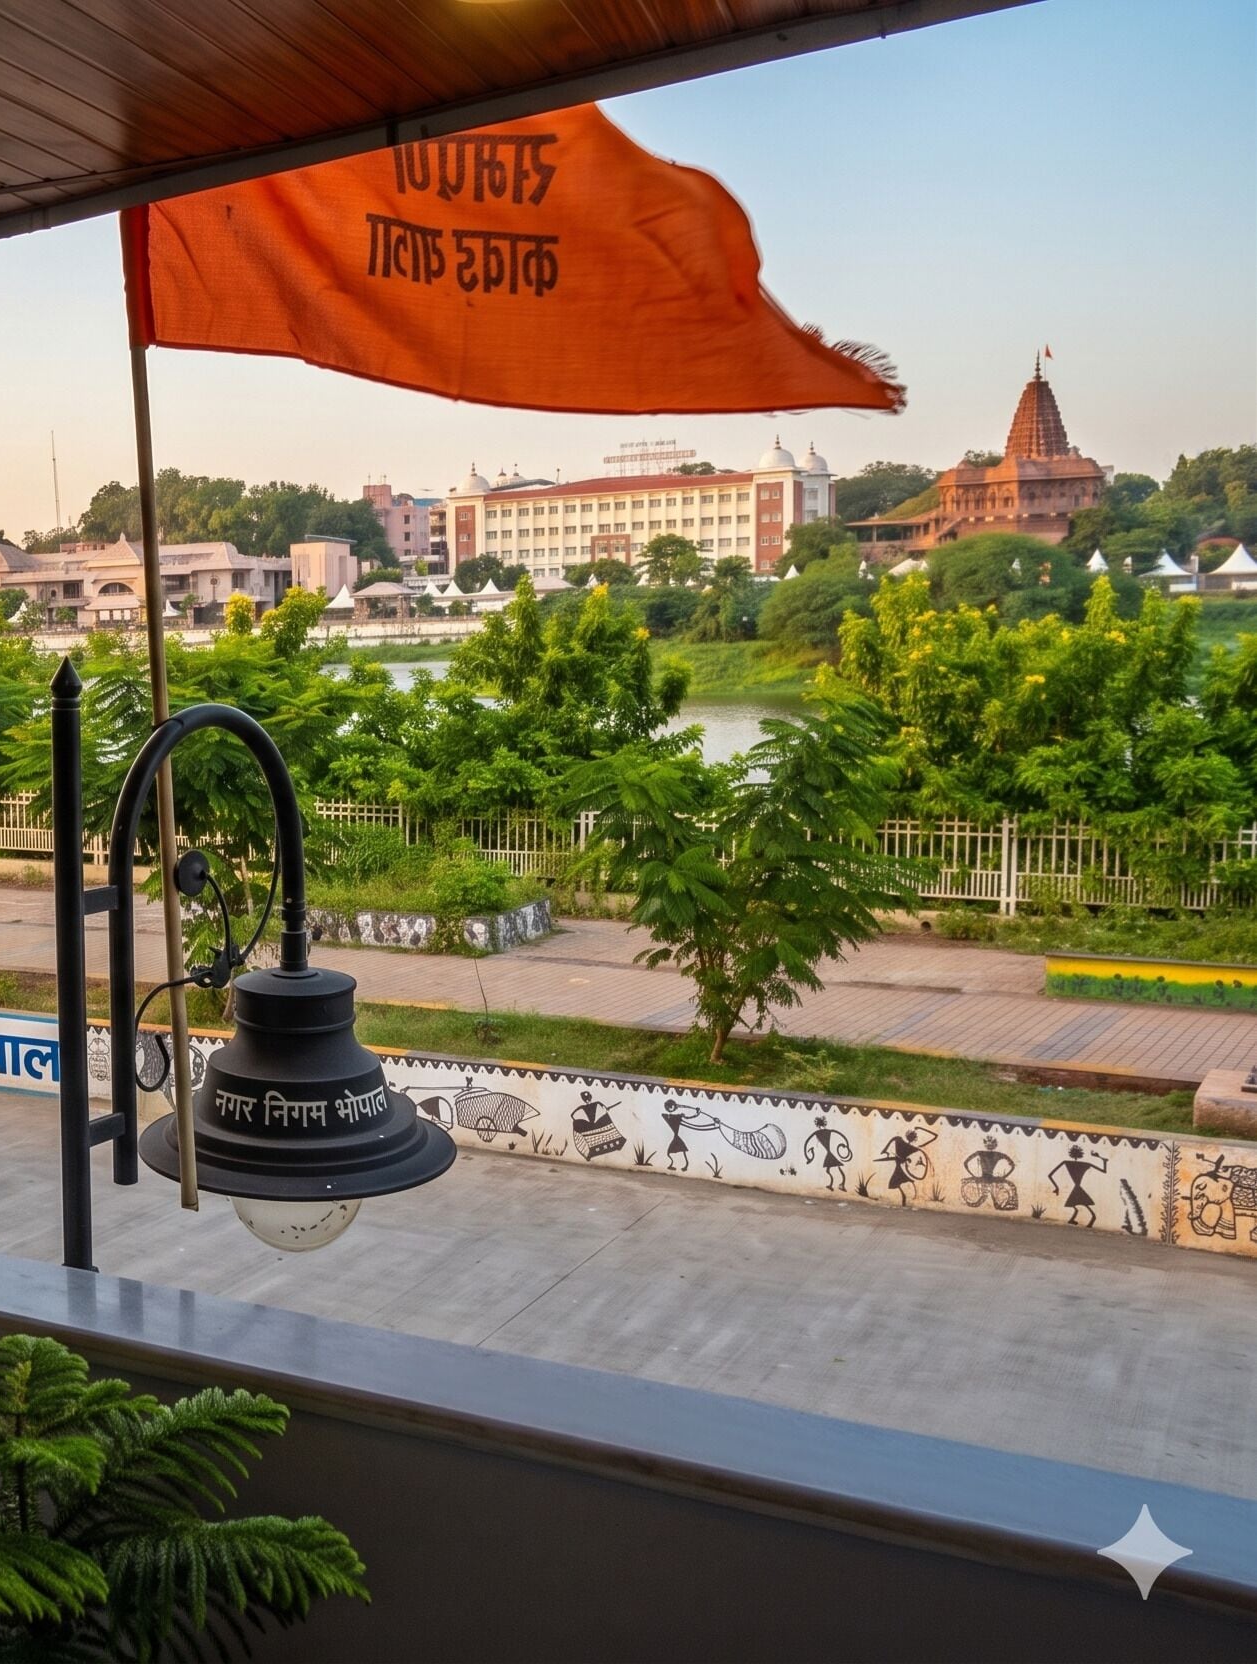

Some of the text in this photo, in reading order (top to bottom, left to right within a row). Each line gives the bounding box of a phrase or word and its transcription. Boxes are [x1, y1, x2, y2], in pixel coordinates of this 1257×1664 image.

[215, 1084, 390, 1127] नगर निगम भोपाल
